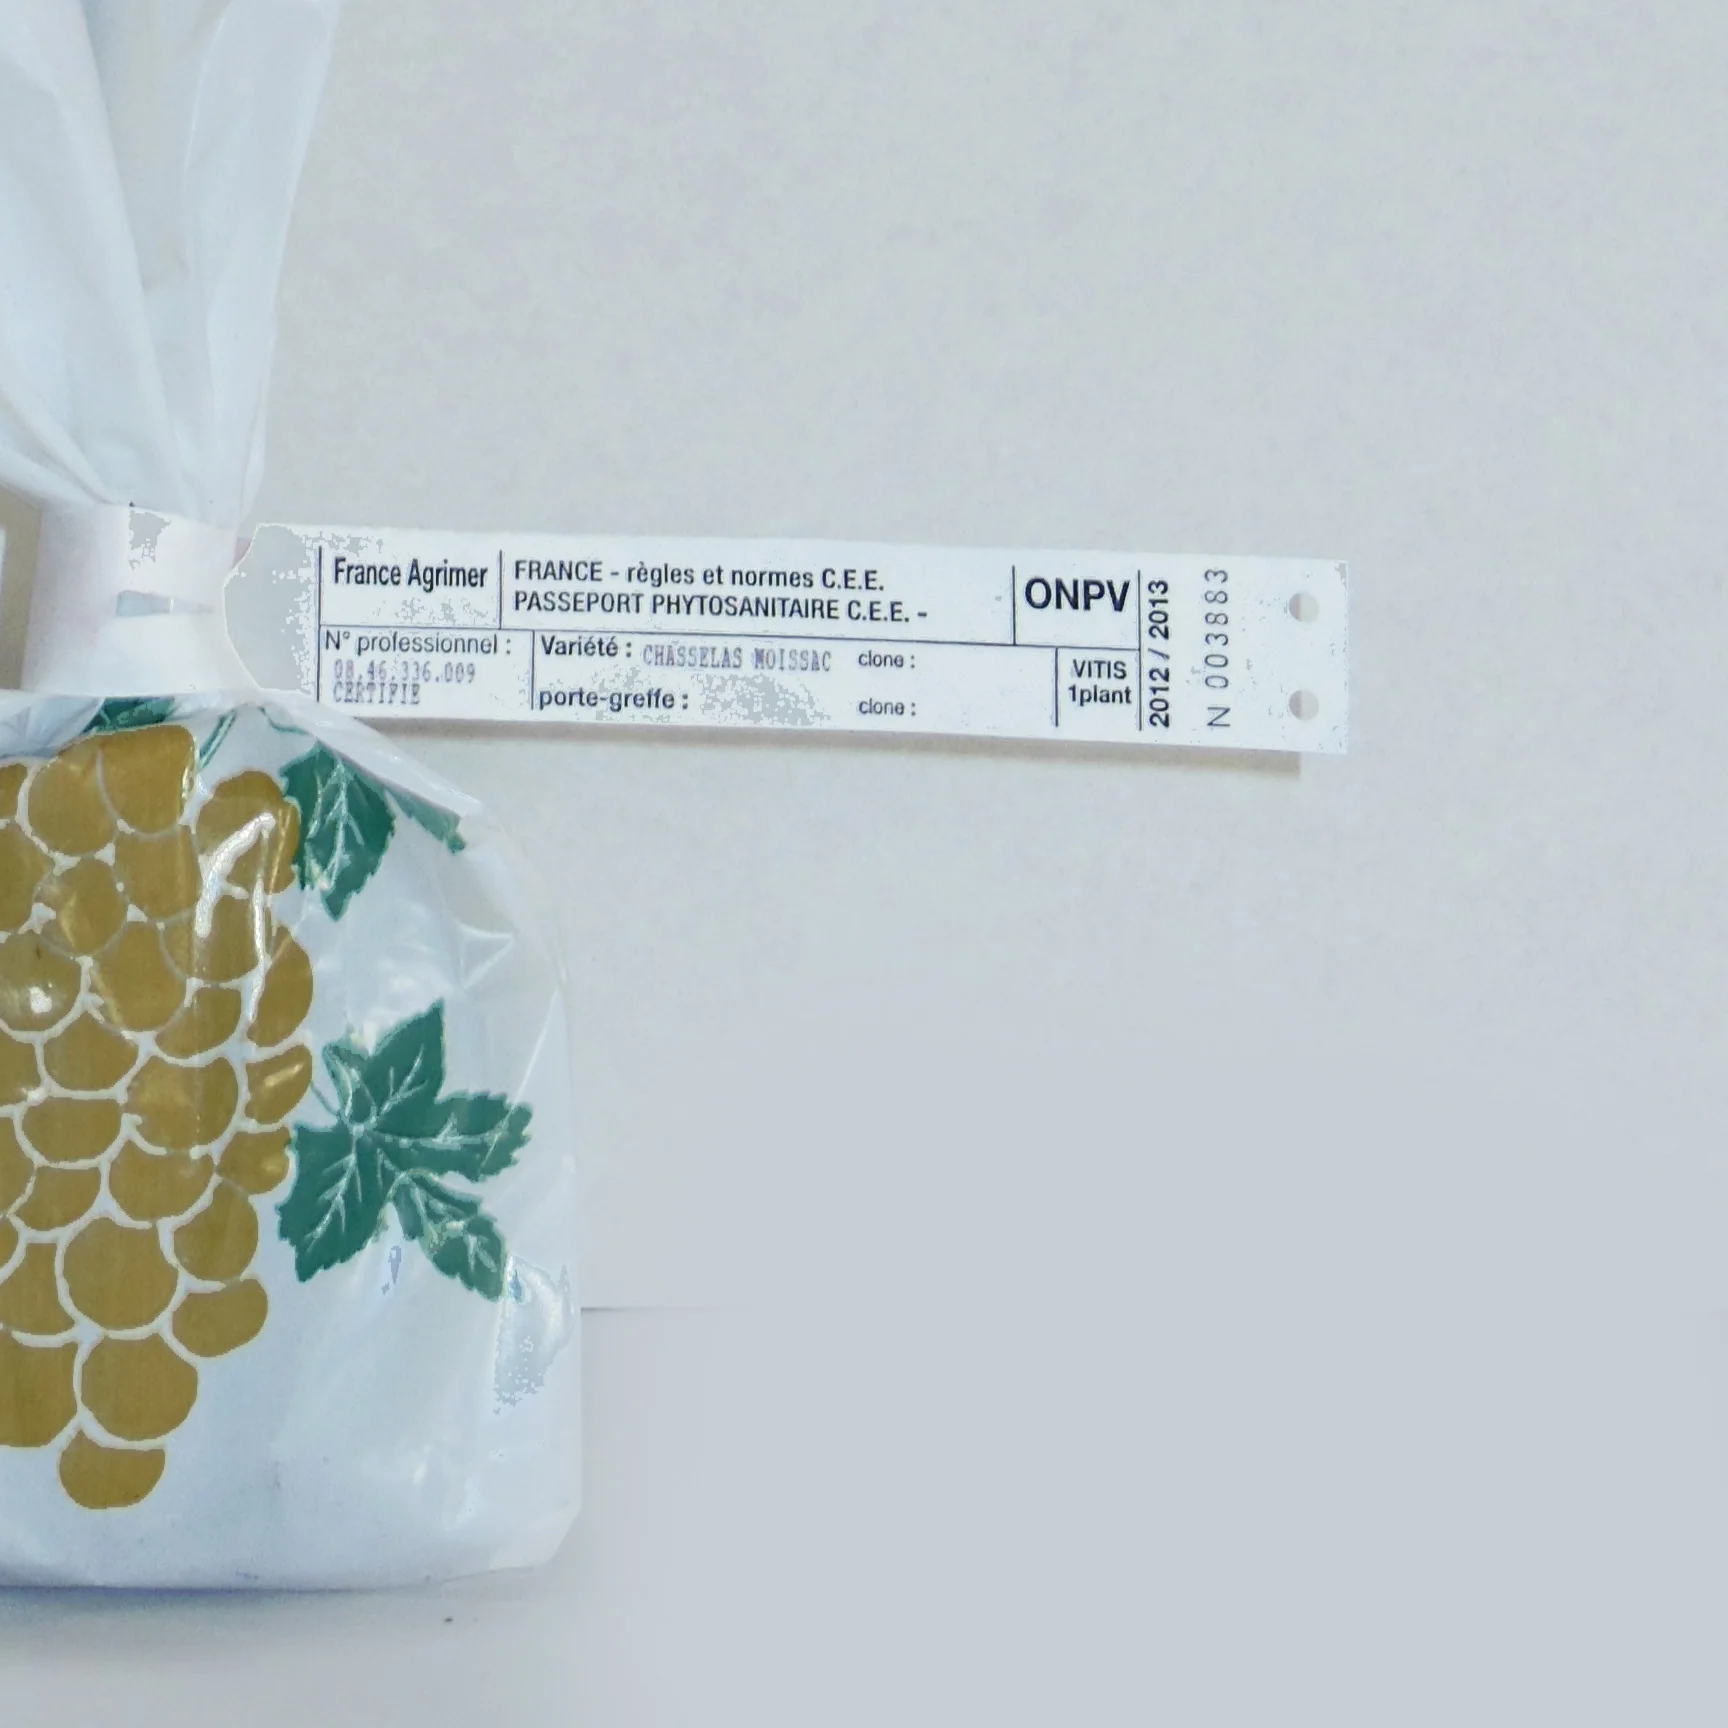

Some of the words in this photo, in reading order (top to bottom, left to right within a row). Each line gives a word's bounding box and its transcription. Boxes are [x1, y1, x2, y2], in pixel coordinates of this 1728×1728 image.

[334, 556, 401, 586] France
[408, 558, 488, 593] Agrimer
[514, 560, 603, 582] FRANCE
[627, 561, 694, 588] règles
[703, 565, 724, 585] et
[731, 570, 814, 589] normes
[822, 568, 884, 591] C.E.E.
[514, 590, 644, 614] PASSEPORT
[652, 594, 840, 620] PHYTOSANITAIRE
[847, 600, 909, 622] C.E.E.
[1025, 577, 1130, 612] ONPV
[1148, 579, 1169, 640] 2013
[325, 630, 350, 651] N°
[357, 631, 498, 656] professionnel
[1204, 569, 1229, 689] 003883
[541, 635, 618, 657] Variété
[643, 644, 742, 669] CHASSELAS
[753, 647, 832, 672] MOISSAC
[858, 650, 904, 668] clone
[1072, 659, 1127, 680] VITIS
[333, 681, 421, 705] CERTIFIE
[539, 687, 675, 712] porte-greffe
[859, 698, 905, 716] clone
[1068, 684, 1132, 707] 1plant
[1149, 667, 1170, 728] 2012
[1206, 706, 1231, 728] N
